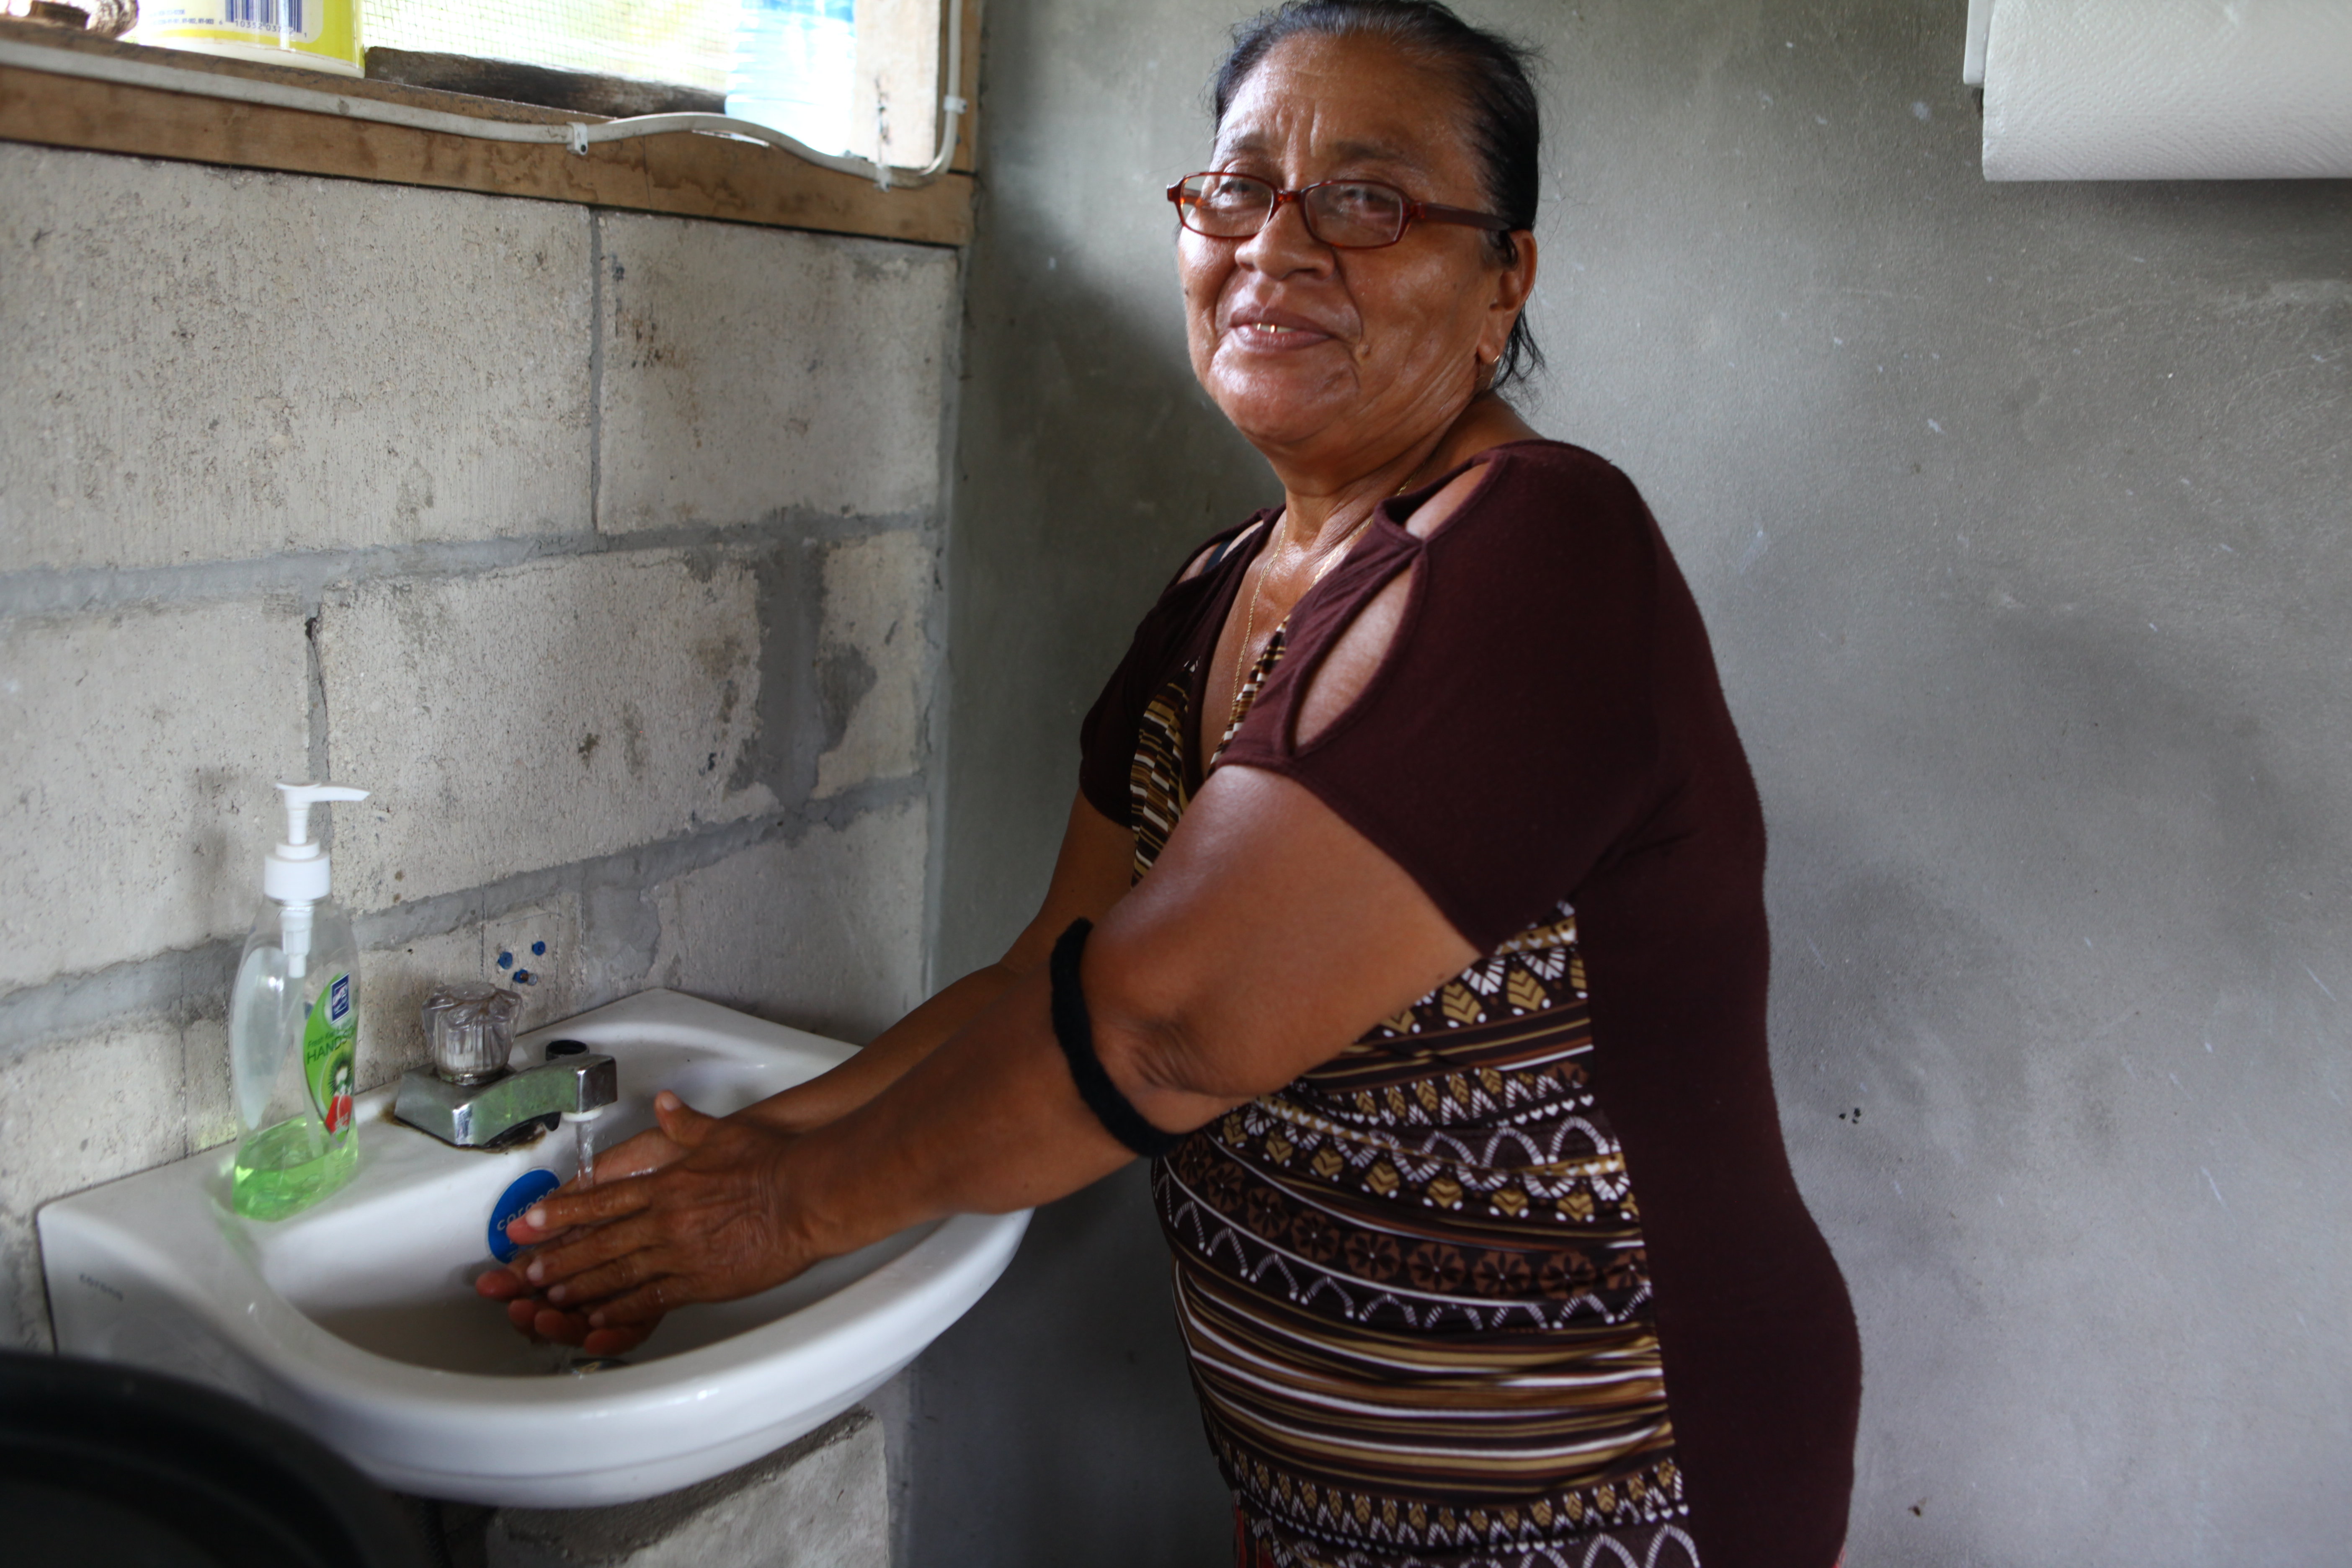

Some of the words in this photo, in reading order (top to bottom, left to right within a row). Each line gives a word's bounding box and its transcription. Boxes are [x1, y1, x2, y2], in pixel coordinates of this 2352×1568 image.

[235, 20, 263, 30] 10352
[266, 24, 294, 35] 0372
[307, 1024, 356, 1065] HANDSO
